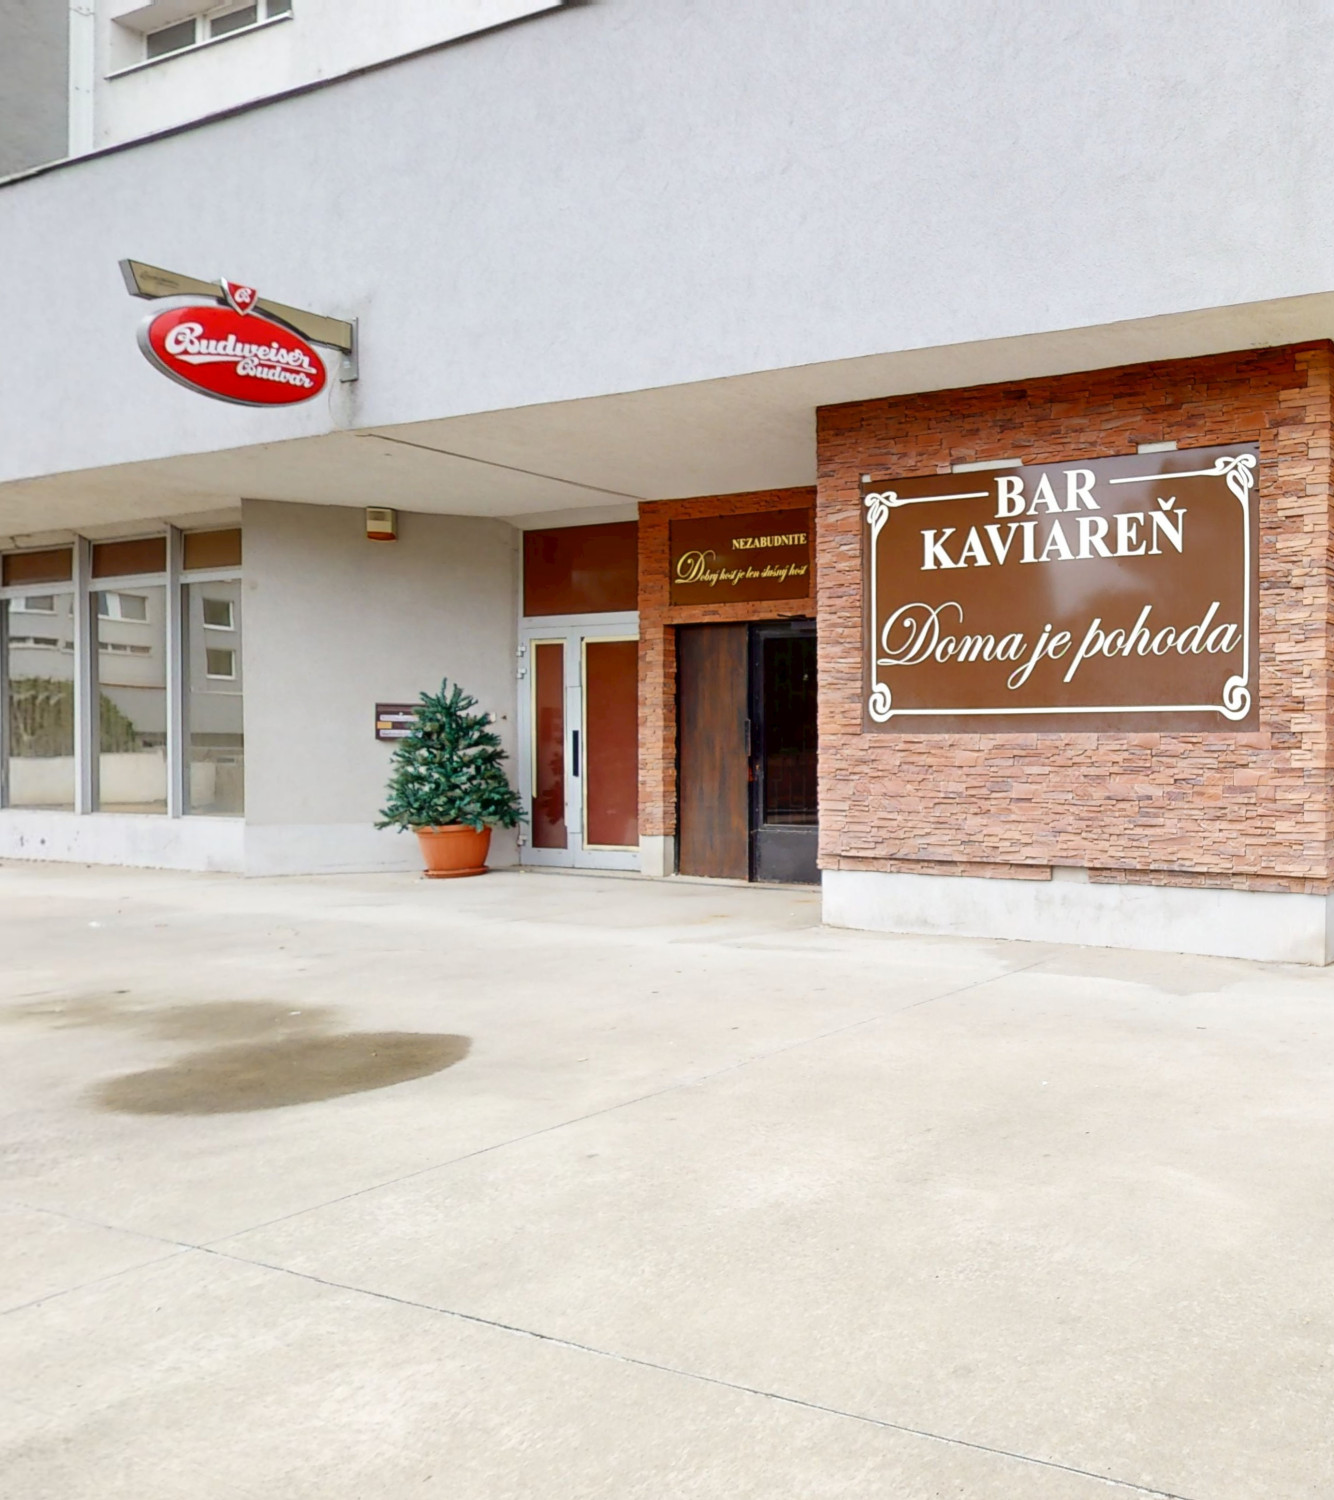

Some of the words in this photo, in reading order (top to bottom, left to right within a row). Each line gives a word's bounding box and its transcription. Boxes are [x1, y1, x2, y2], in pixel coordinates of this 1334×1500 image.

[164, 321, 314, 371] Budweiser
[236, 357, 314, 388] Budvar
[994, 469, 1101, 519] BAR
[732, 533, 807, 550] NEZABUDNITE
[920, 496, 1188, 571] KAVIAREŇ
[877, 602, 1027, 667] Doma
[1007, 623, 1071, 691] je
[1063, 601, 1242, 683] pohoda
